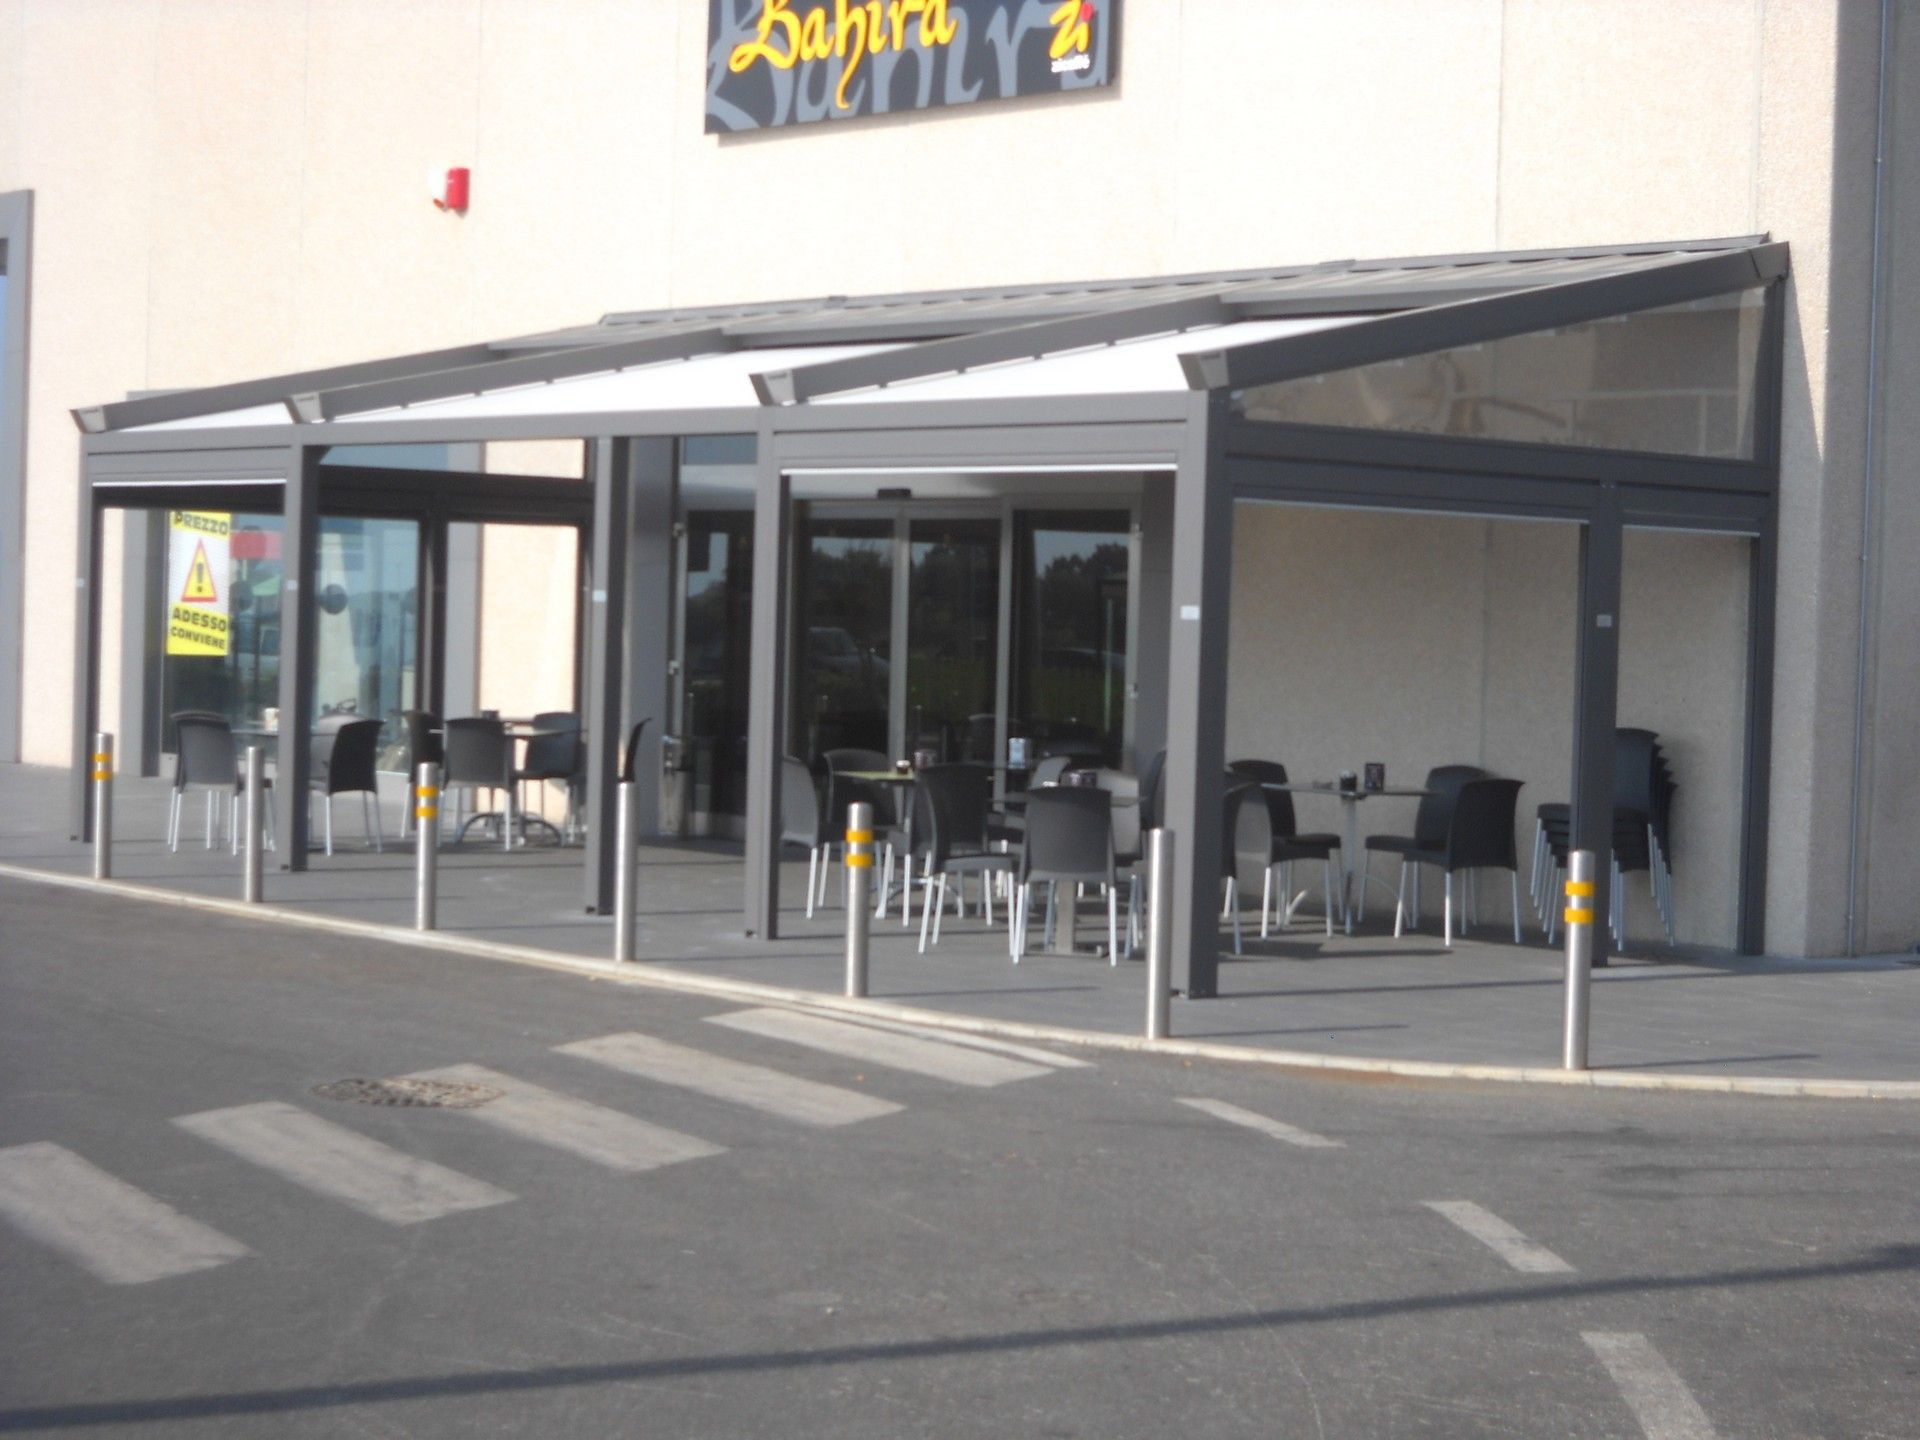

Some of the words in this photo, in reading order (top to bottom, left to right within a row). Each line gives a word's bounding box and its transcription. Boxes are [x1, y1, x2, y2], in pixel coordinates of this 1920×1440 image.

[728, 0, 958, 109] Bahira
[174, 511, 228, 535] PREZZO
[172, 607, 227, 632] ADESSO
[171, 626, 225, 650] CONVIENE
